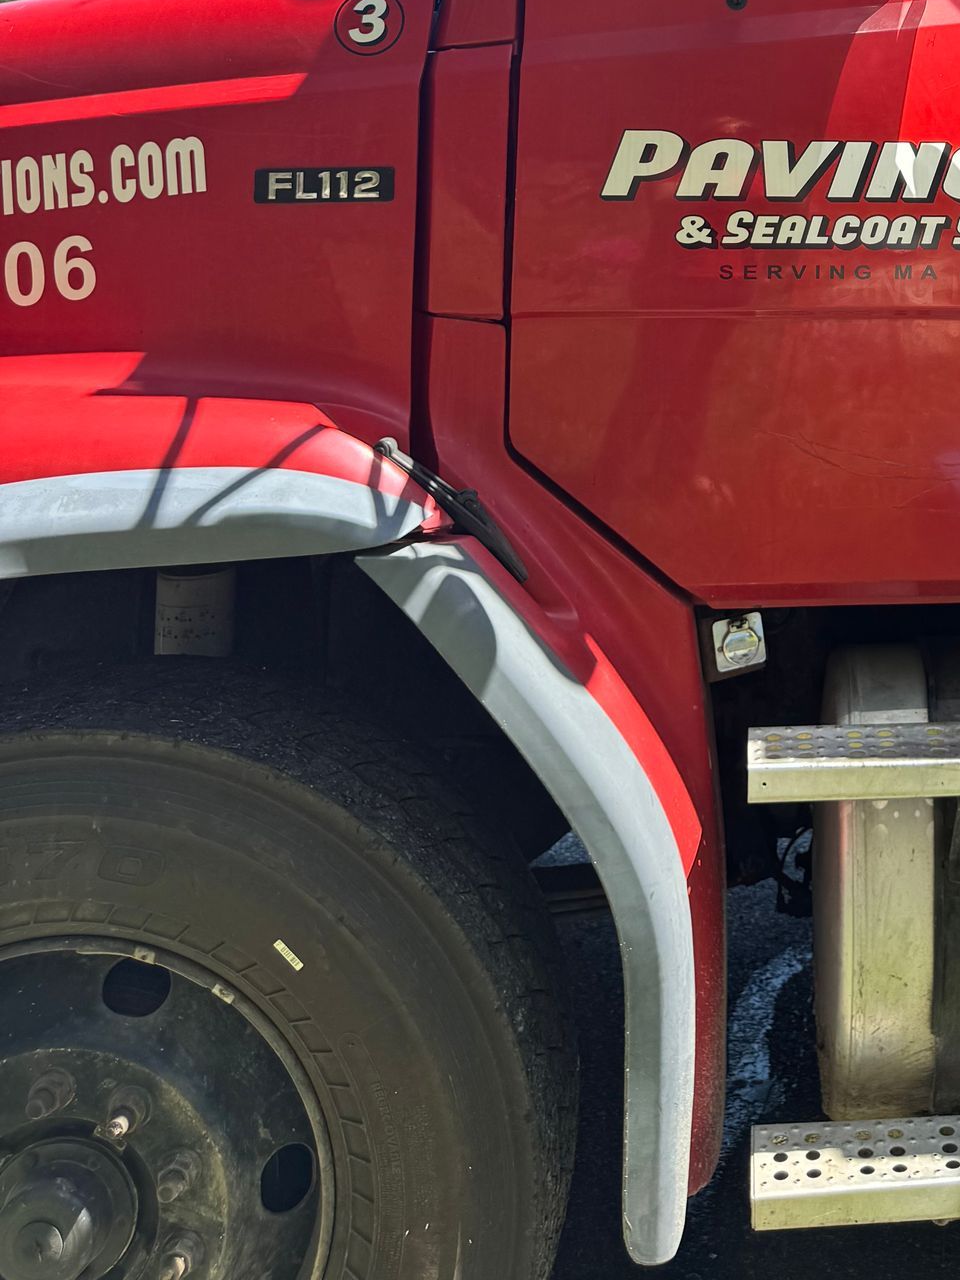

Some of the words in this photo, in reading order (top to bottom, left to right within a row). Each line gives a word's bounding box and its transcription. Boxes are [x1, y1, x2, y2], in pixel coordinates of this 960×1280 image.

[267, 170, 381, 200] FL112
[675, 215, 714, 247] &
[721, 211, 950, 248] SEALCOAT
[4, 235, 97, 307] 06
[718, 264, 873, 280] SERVING
[894, 264, 938, 280] MA
